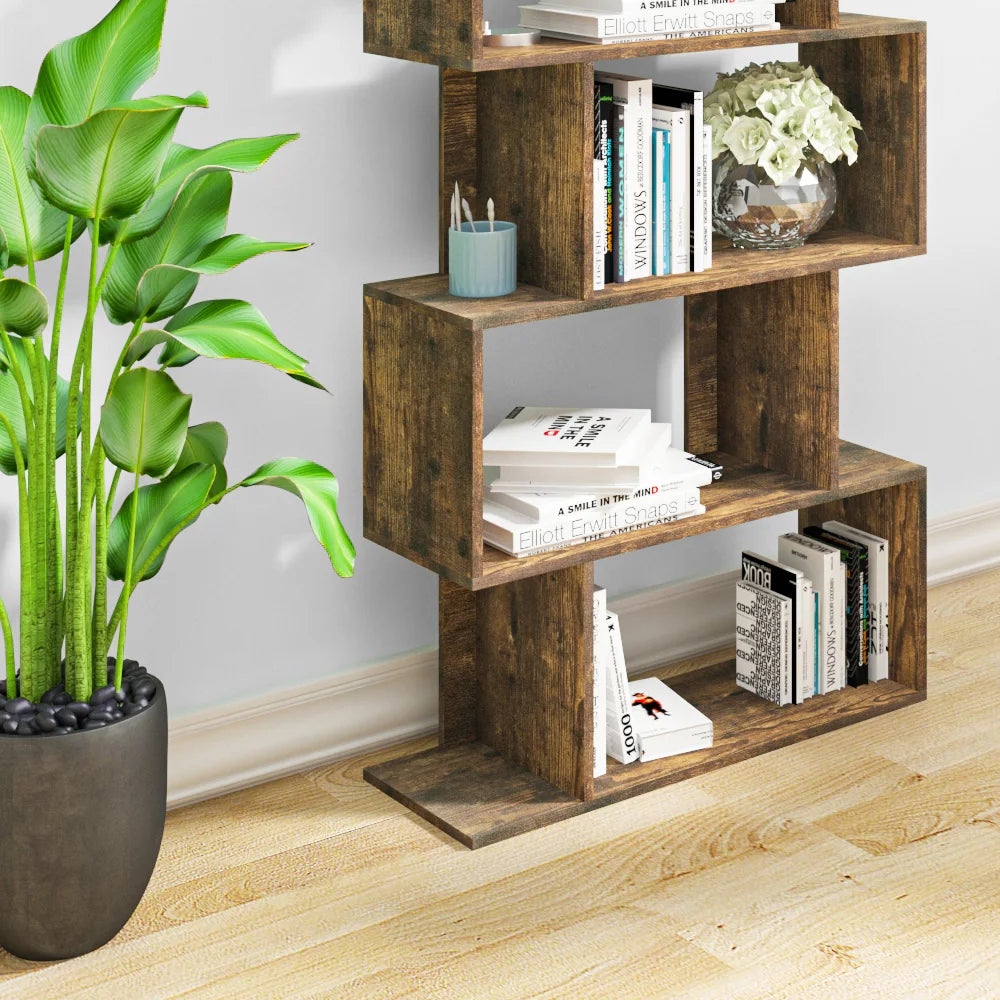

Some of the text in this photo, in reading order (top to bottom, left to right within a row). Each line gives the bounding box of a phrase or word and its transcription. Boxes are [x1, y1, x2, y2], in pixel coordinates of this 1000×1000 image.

[640, 2, 647, 10] A
[649, 0, 677, 9] SMILE
[604, 10, 754, 36] Elliott Erwitt Snaps
[663, 32, 683, 40] THE
[689, 26, 755, 39] AMERICANS
[600, 119, 608, 166] Architects
[634, 190, 647, 270] WINDOWS
[543, 415, 573, 437] MIND
[560, 416, 593, 440] IN THE
[574, 423, 606, 448] SMILE
[557, 508, 565, 517] A
[567, 500, 597, 514] SMILE
[600, 497, 611, 507] IN
[613, 494, 630, 503] THE
[633, 486, 659, 498] MIND
[519, 501, 679, 550] Elliott Erwitt Snaps
[582, 533, 602, 543] THE
[609, 514, 679, 537] AMERICANS
[743, 562, 772, 590] BOOK
[826, 629, 837, 688] WINDOWS
[621, 713, 637, 756] 1000
